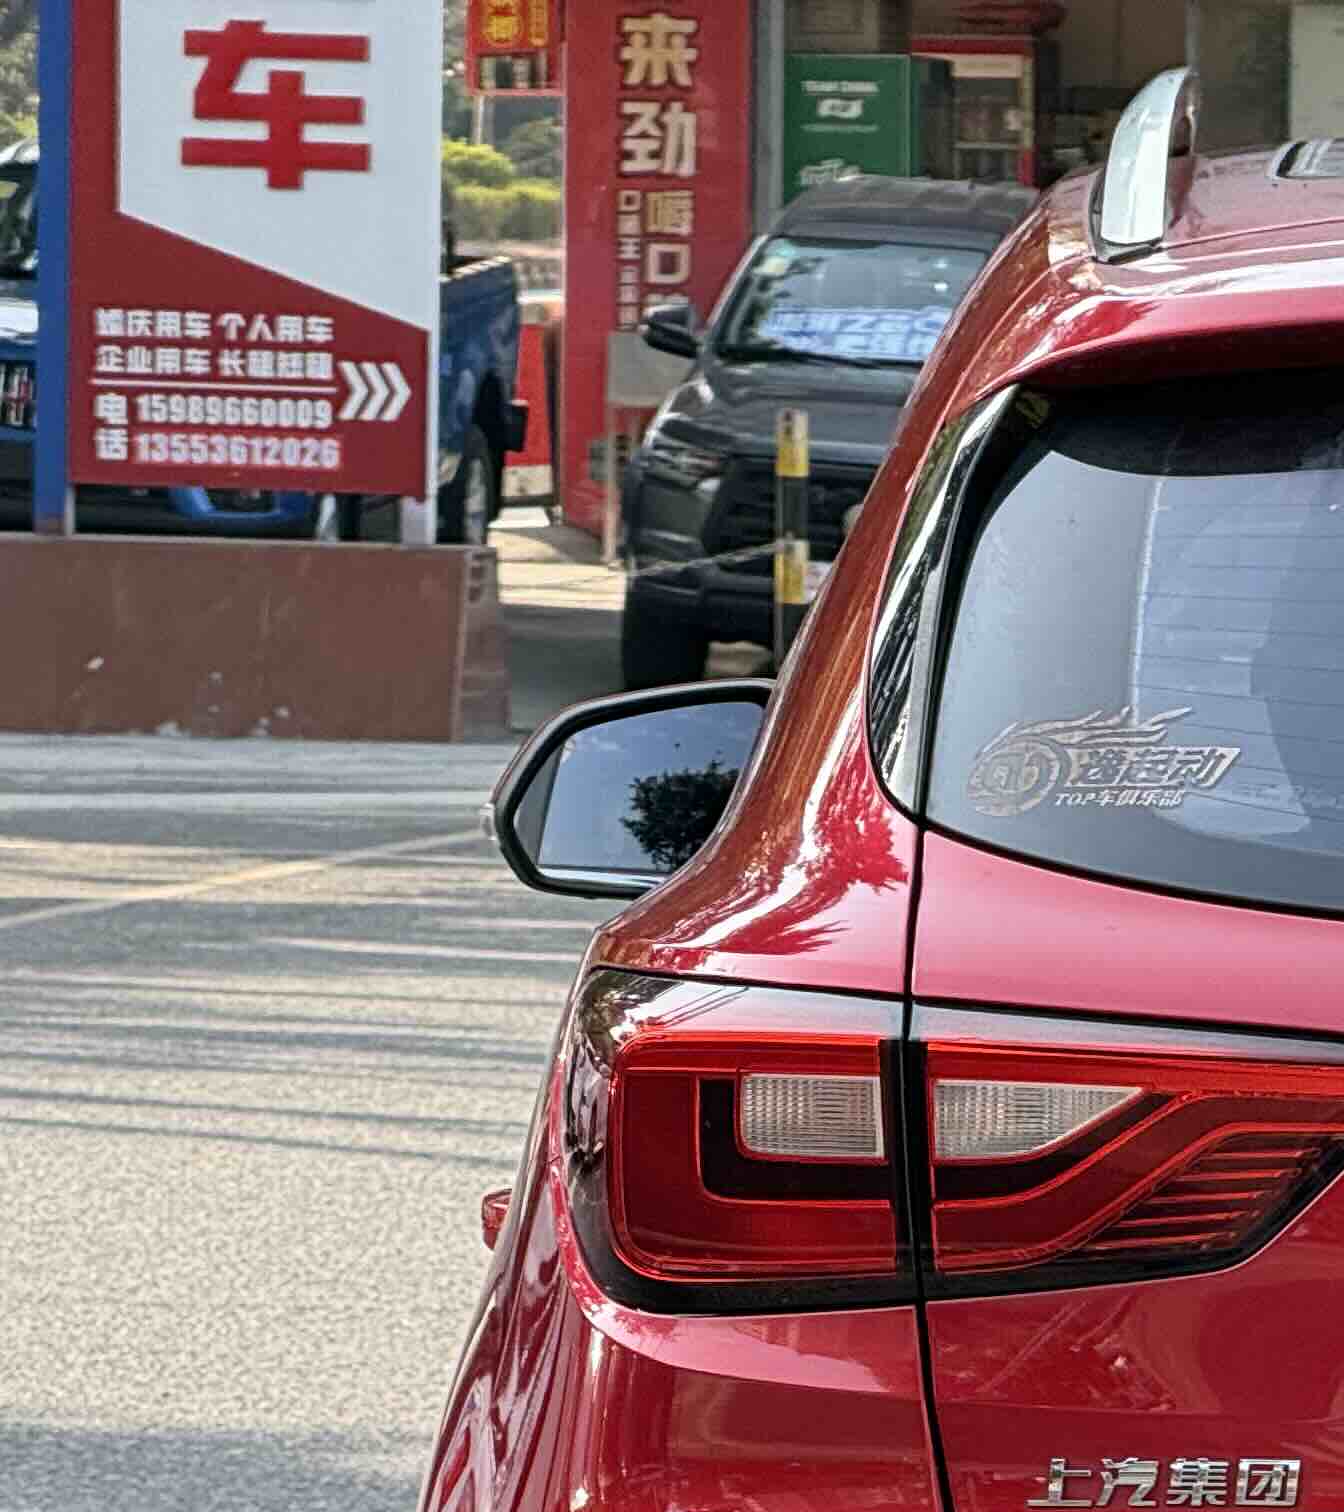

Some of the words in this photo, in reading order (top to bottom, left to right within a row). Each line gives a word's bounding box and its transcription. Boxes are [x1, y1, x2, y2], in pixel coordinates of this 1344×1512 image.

[181, 20, 372, 190] 车
[618, 12, 698, 178] 来劲
[217, 312, 334, 343] 个人用车
[96, 344, 211, 374] 企业用车
[136, 394, 334, 429] 15989660009
[134, 432, 342, 470] 13553612026
[1027, 1457, 1301, 1507] 上汽集团
